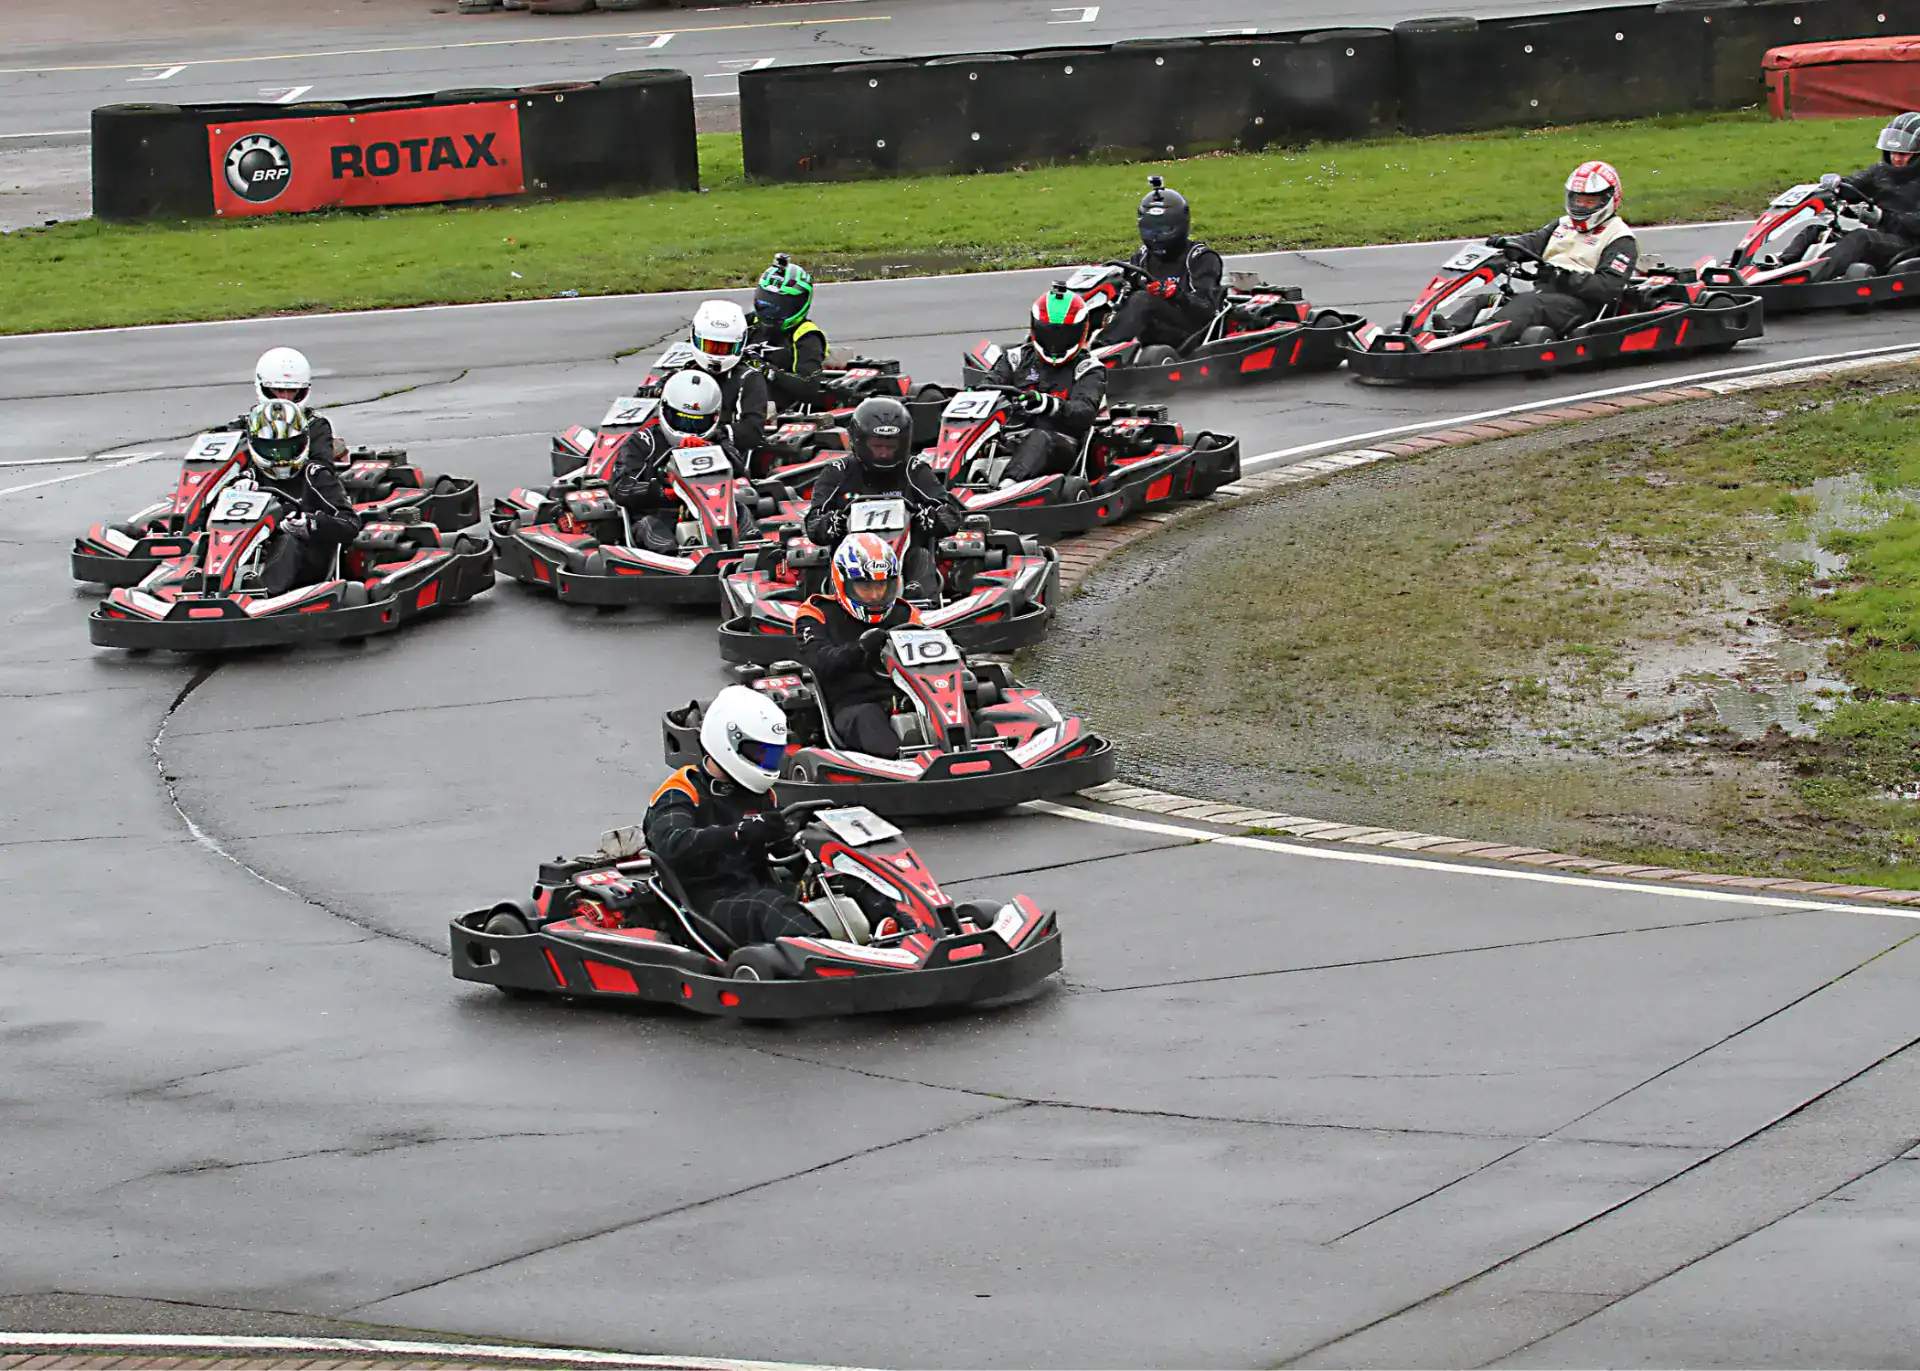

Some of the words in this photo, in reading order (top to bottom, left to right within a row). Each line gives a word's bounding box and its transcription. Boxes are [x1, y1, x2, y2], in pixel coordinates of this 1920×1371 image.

[330, 132, 500, 180] ROTAX
[251, 167, 290, 182] BRP
[1455, 253, 1481, 267] 3
[661, 351, 694, 364] 12
[616, 407, 642, 420] 4
[951, 400, 989, 415] 21
[199, 442, 228, 457] 5
[691, 456, 714, 471] 9
[226, 501, 254, 517] 8
[864, 509, 892, 527] 11
[901, 641, 947, 661] 10
[850, 820, 873, 837] 1
